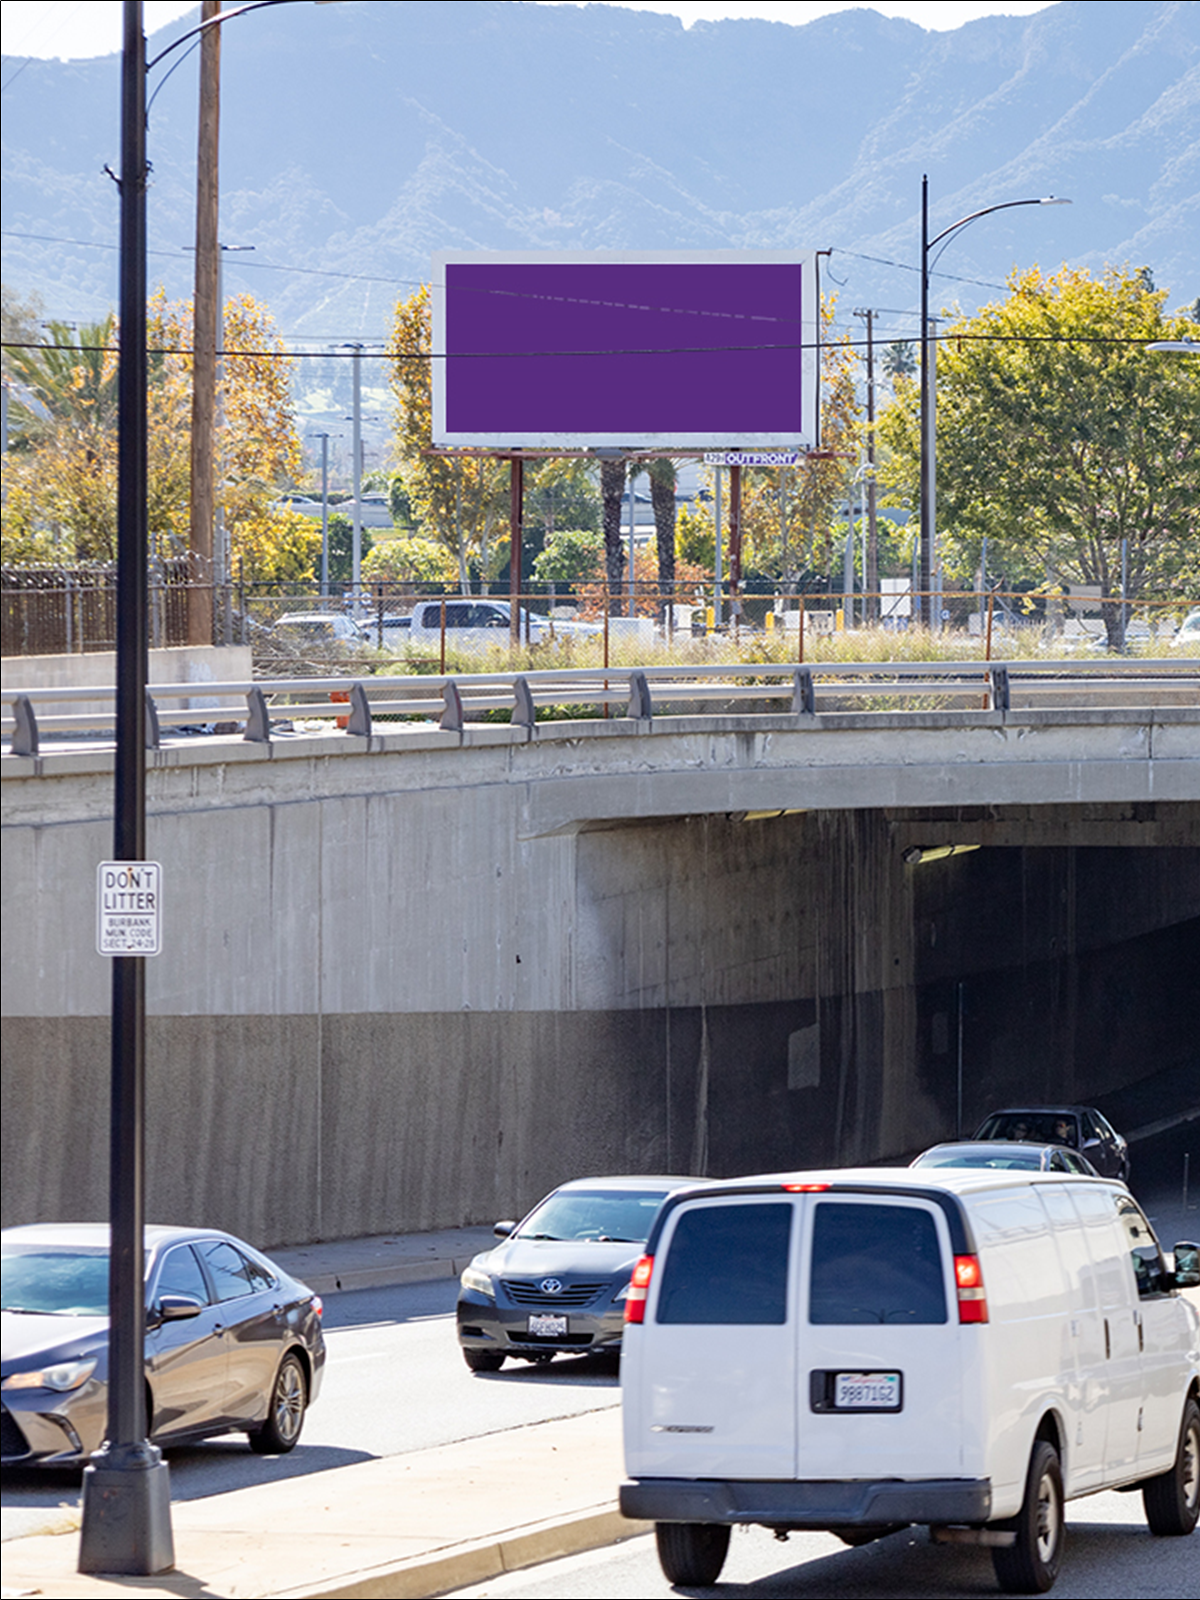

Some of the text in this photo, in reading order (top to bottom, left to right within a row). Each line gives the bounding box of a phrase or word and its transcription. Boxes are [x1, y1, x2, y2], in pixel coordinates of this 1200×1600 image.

[726, 453, 797, 464] OUTFRONT
[106, 867, 153, 888] DON'T
[104, 893, 155, 910] LITTER
[108, 918, 151, 927] BURBANK
